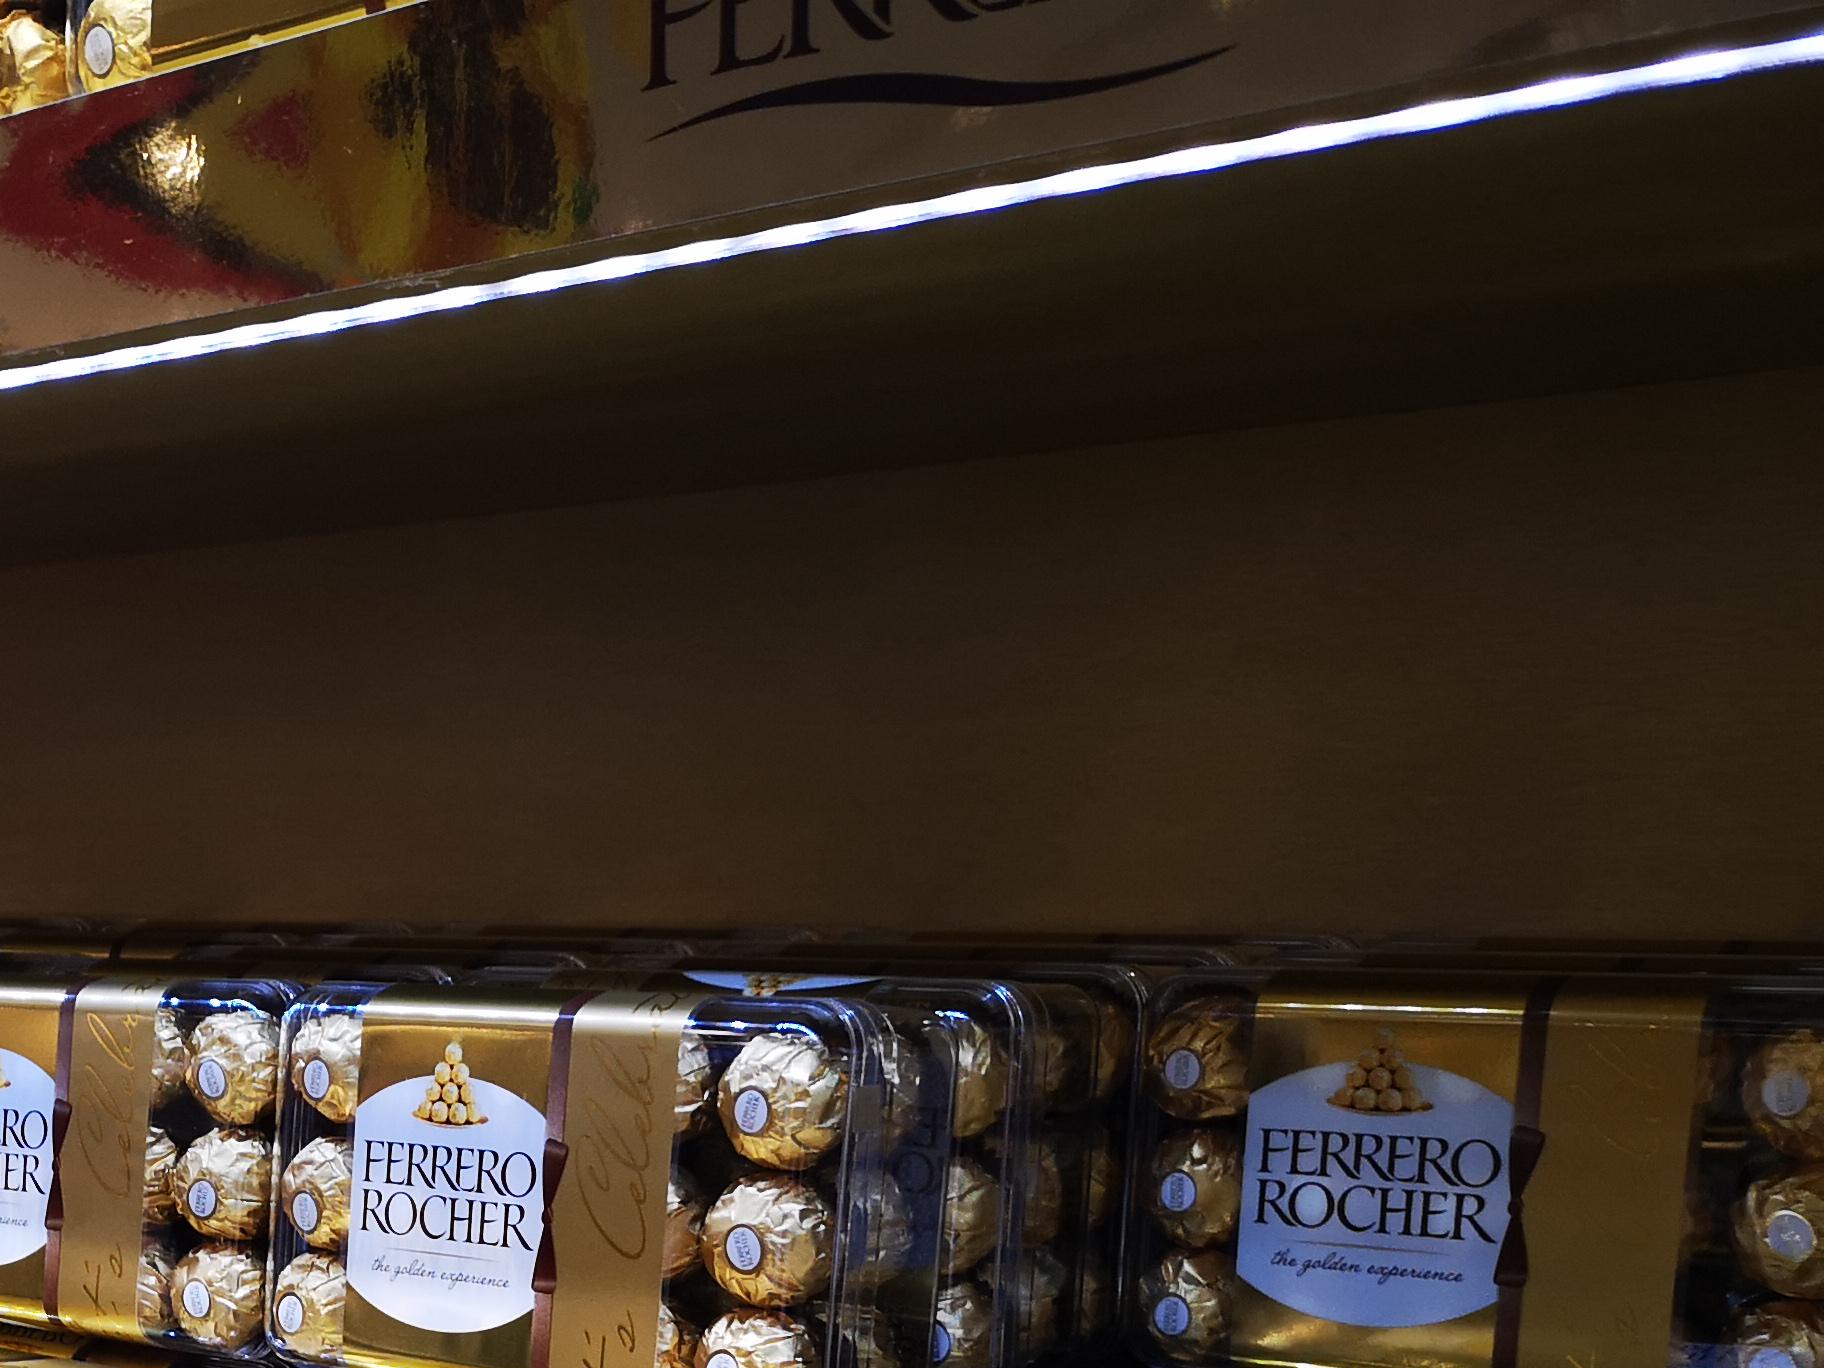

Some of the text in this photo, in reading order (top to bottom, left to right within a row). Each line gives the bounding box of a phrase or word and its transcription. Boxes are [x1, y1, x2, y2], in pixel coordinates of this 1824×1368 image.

[365, 1139, 536, 1199] FERRERO
[1260, 1128, 1502, 1188] FERRERO
[361, 1188, 534, 1253] ROCHER
[1254, 1179, 1498, 1244] ROCHER
[372, 1258, 511, 1290] the golden experience
[1271, 1249, 1464, 1284] the golden experience
